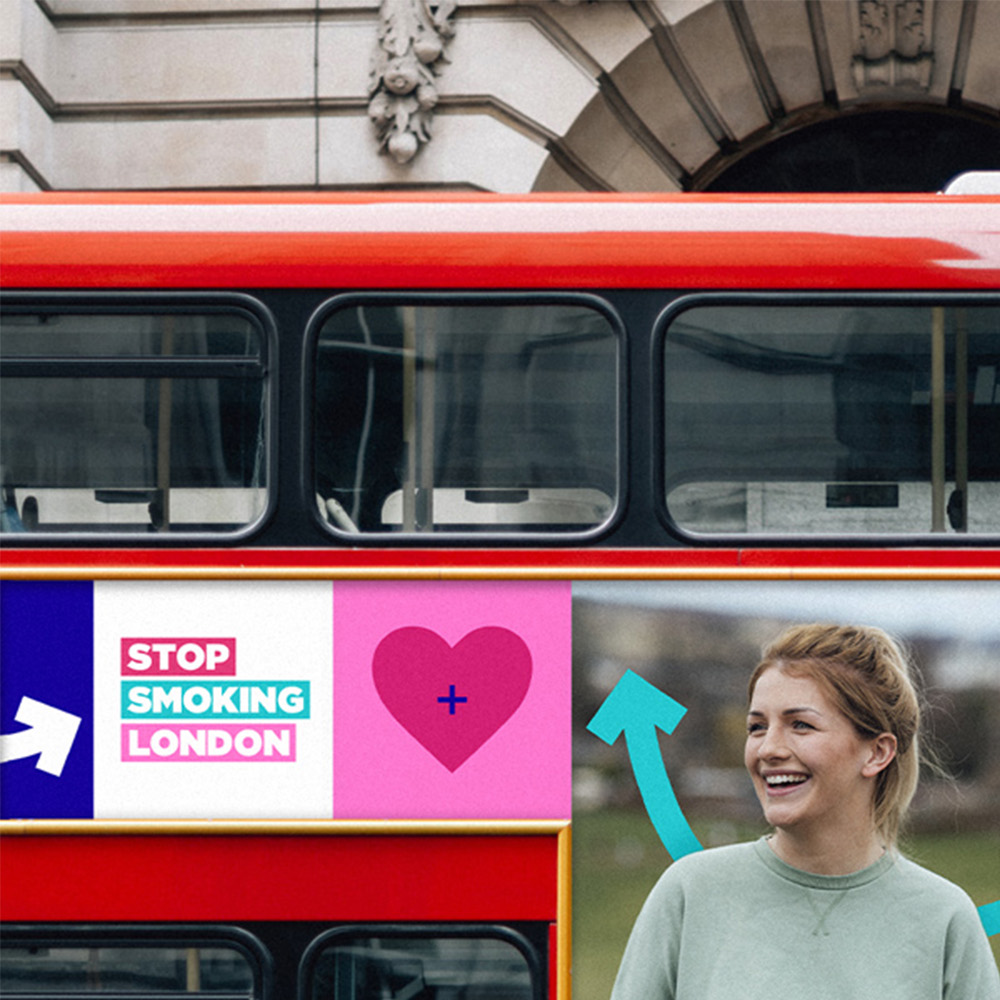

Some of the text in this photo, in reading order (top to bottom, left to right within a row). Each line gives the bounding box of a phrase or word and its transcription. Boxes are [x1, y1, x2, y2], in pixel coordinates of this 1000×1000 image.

[127, 643, 229, 670] STOP
[127, 686, 304, 713] SMOKING
[127, 729, 290, 757] LONDON
